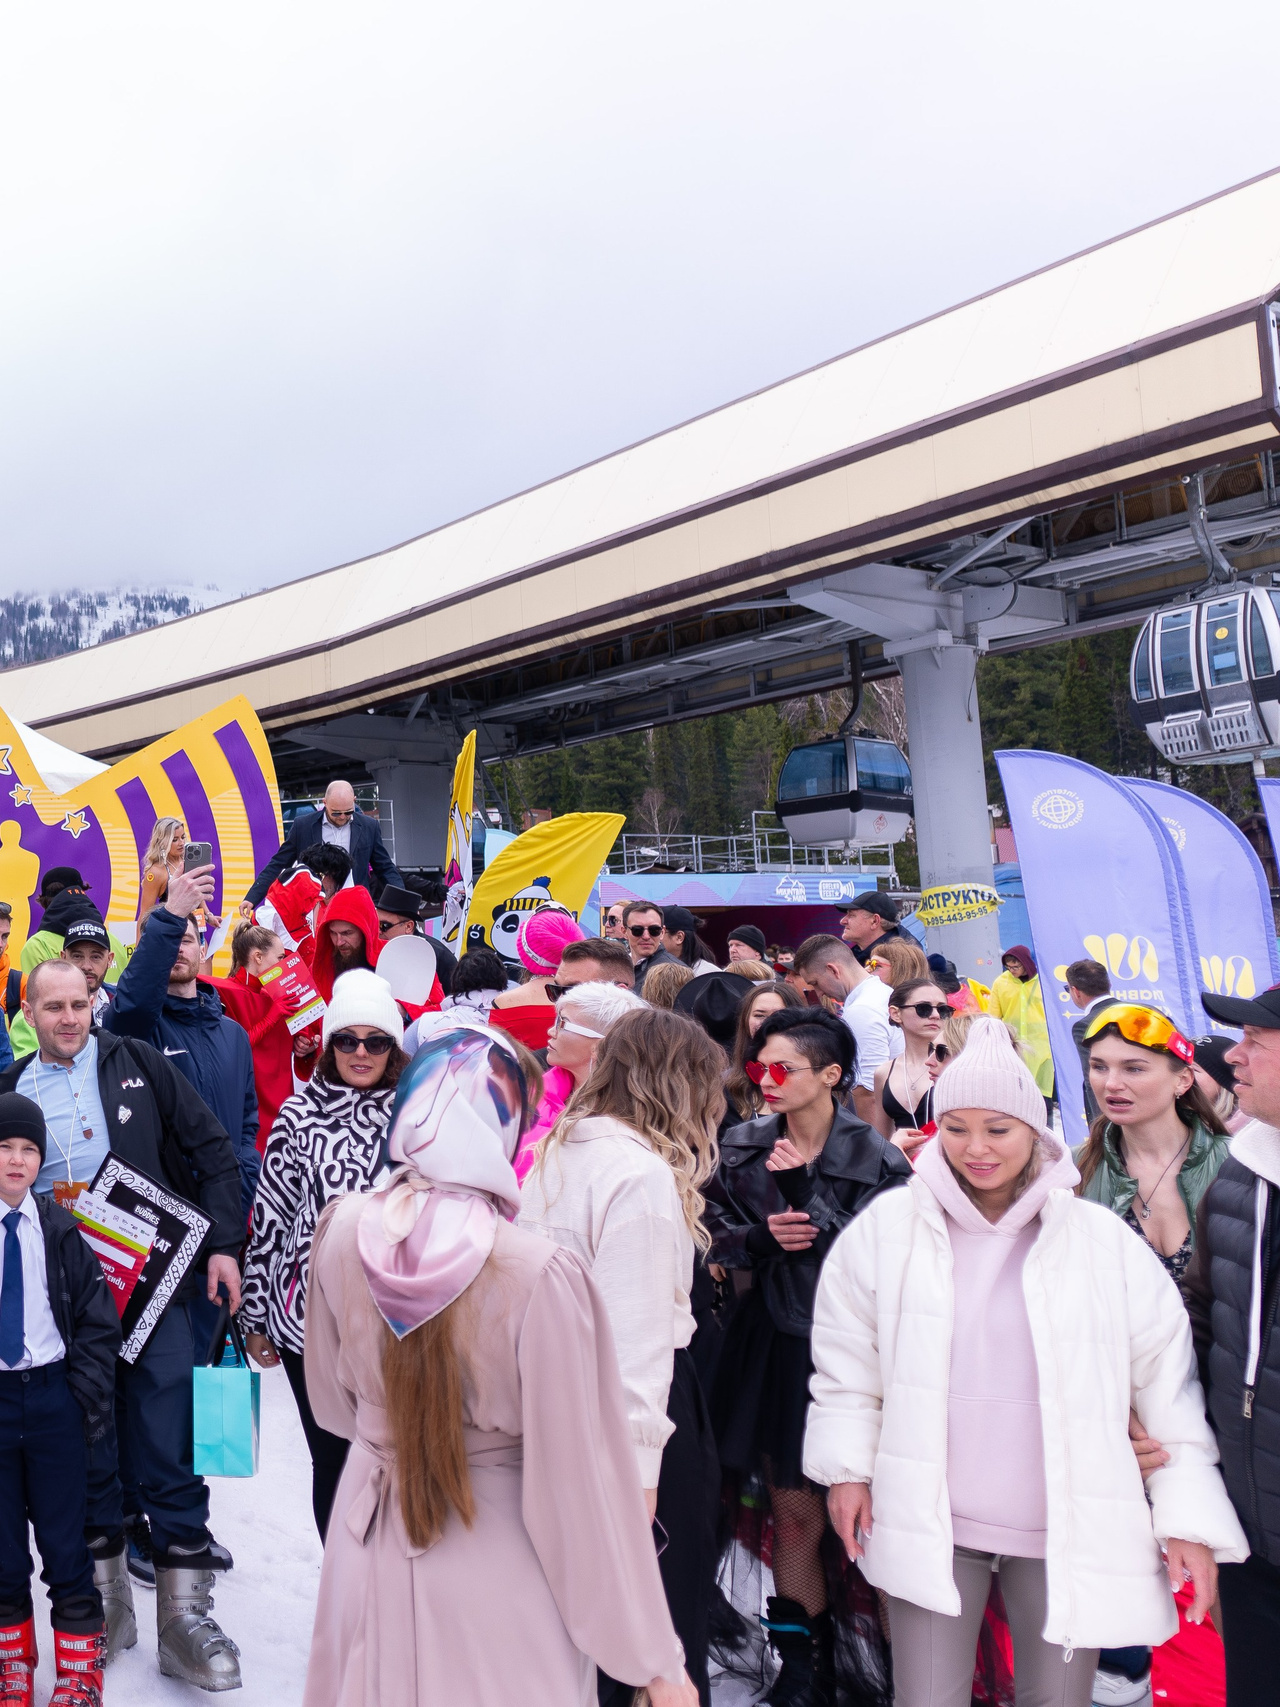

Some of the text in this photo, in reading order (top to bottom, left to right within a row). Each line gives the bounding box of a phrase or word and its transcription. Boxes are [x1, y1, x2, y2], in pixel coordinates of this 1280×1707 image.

[919, 889, 997, 912] НСТРУКТО
[68, 924, 105, 936] SHEREGESH
[286, 956, 300, 968] 2024
[121, 1078, 144, 1090] FILA
[134, 1205, 160, 1225] BUDDIES
[107, 1274, 126, 1290] Приз
